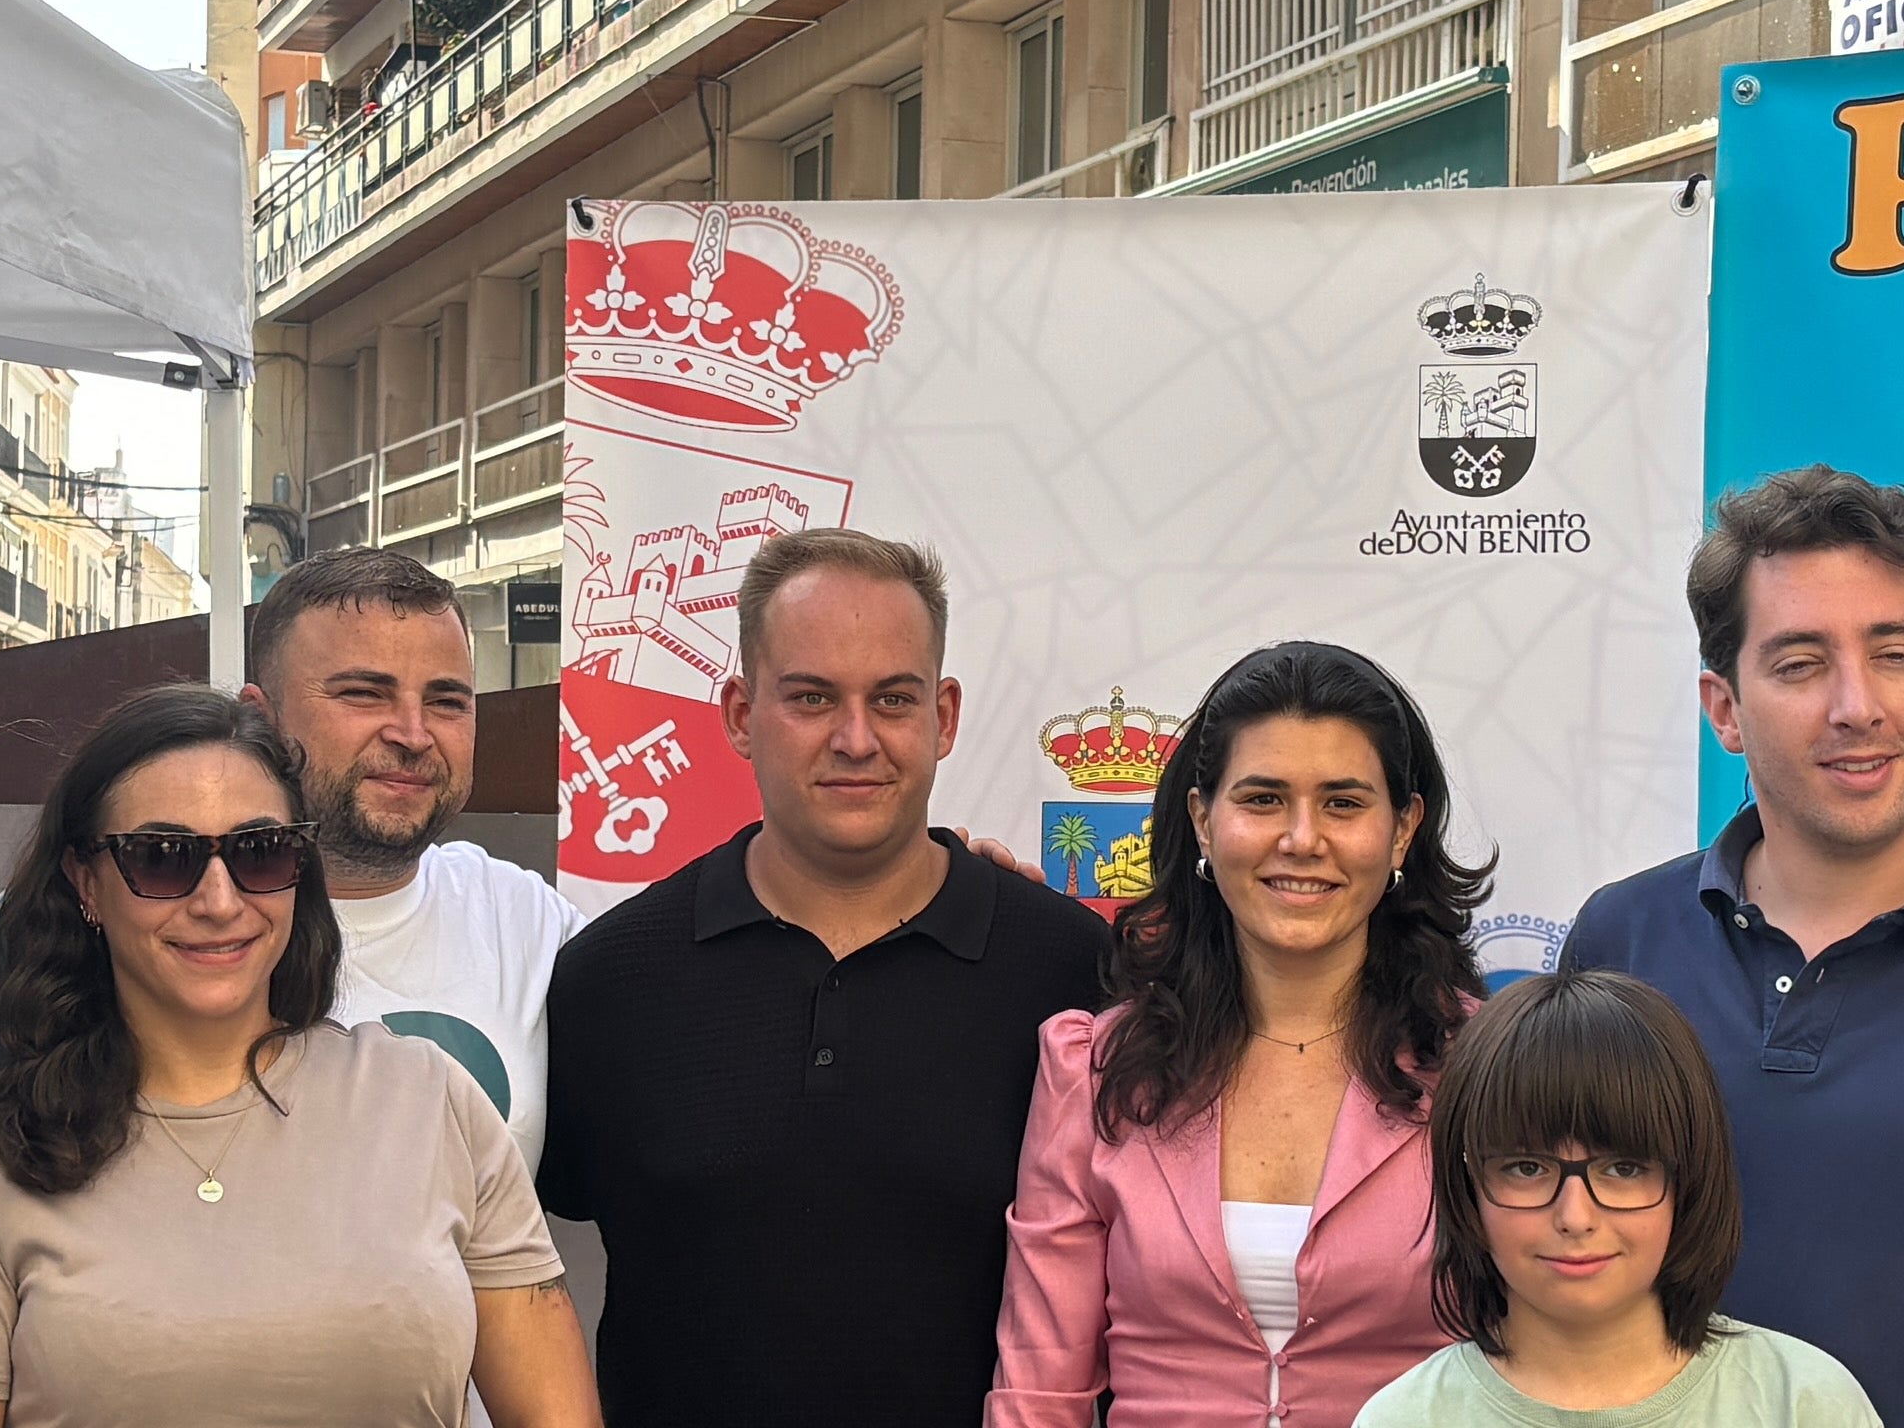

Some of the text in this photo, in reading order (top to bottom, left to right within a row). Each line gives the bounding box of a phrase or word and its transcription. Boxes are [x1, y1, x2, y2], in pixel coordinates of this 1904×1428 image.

[1390, 508, 1586, 535] Ayuntamiento
[1359, 528, 1591, 556] deDON BENITO
